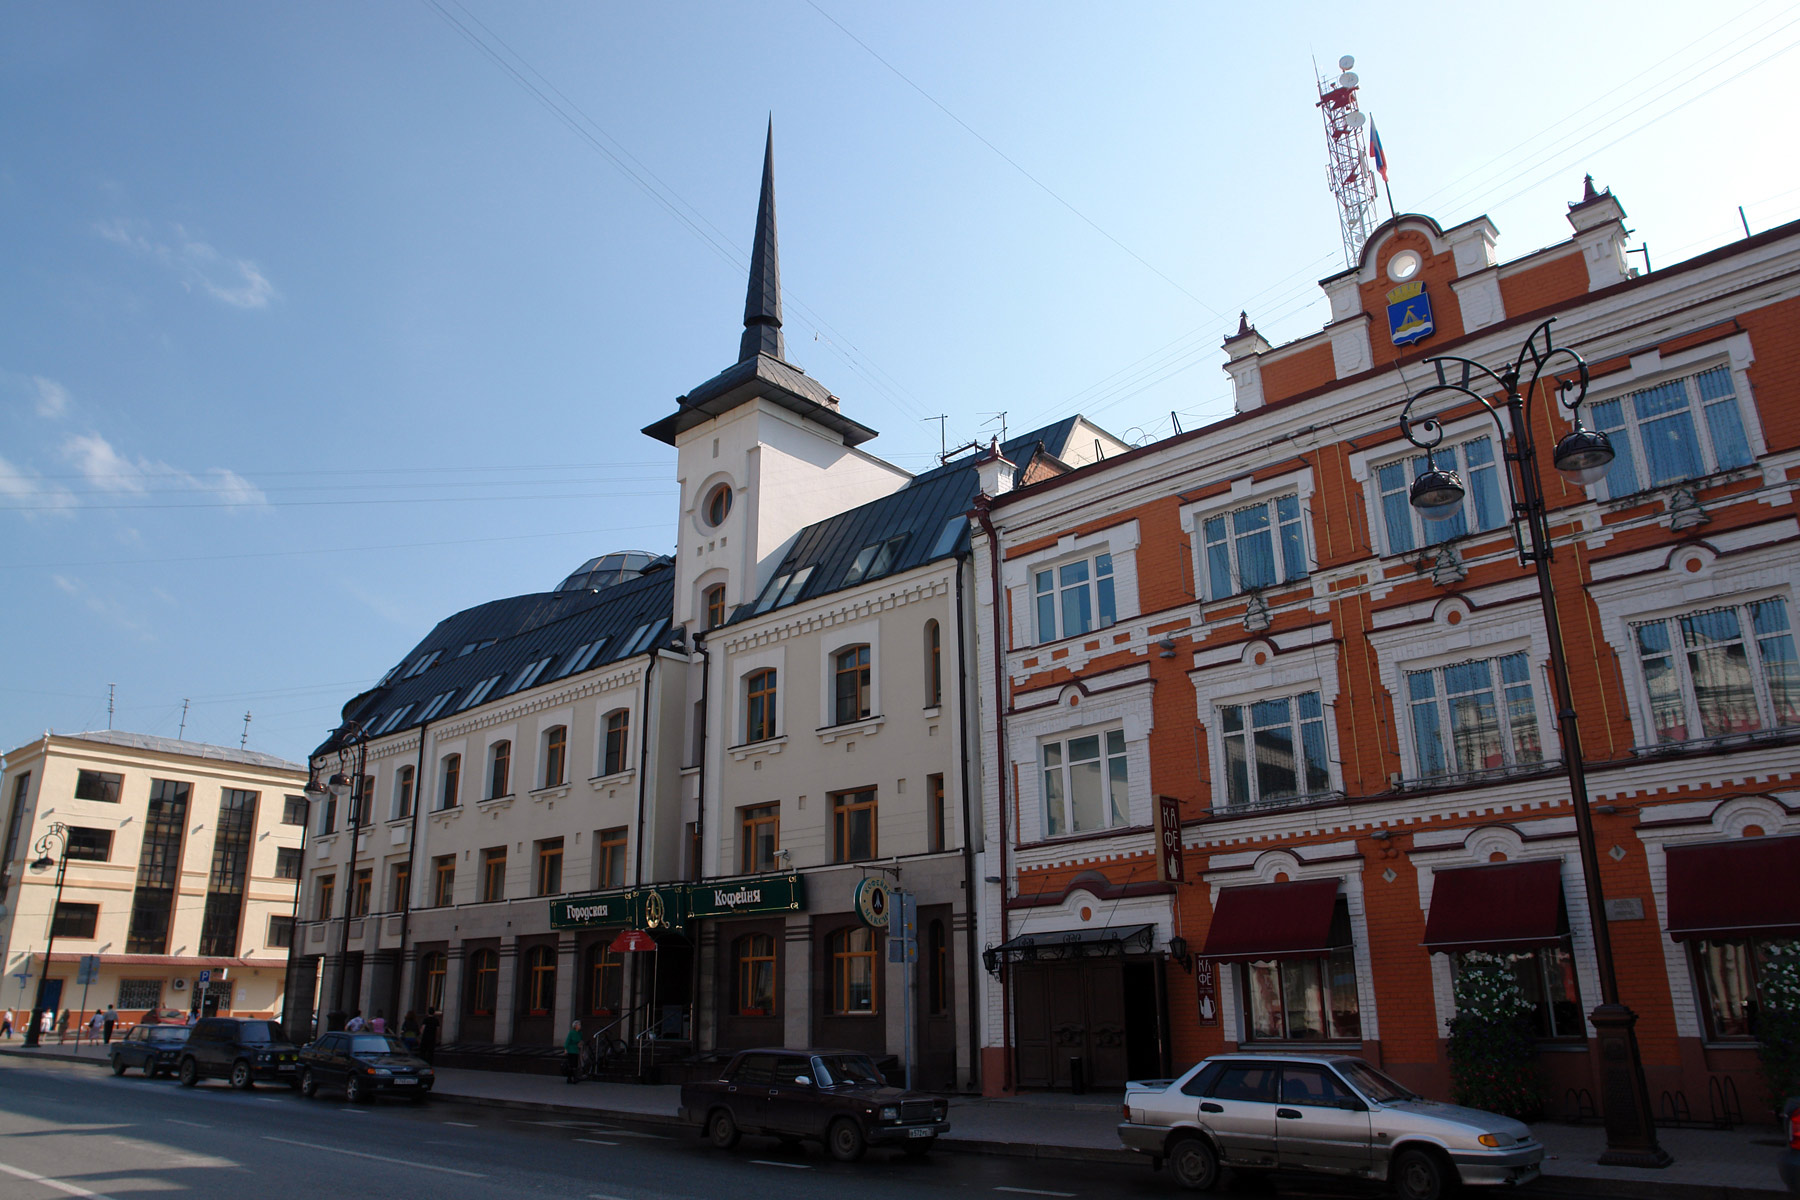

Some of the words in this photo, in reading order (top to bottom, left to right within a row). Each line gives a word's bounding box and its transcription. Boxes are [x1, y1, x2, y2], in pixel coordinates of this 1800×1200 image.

[1162, 806, 1178, 829] КА
[1164, 829, 1180, 852] ФЕ
[566, 904, 608, 922] Городская
[714, 886, 761, 908] Кофейня
[864, 908, 889, 925] МАКСИ
[1198, 972, 1213, 986] ФЕ
